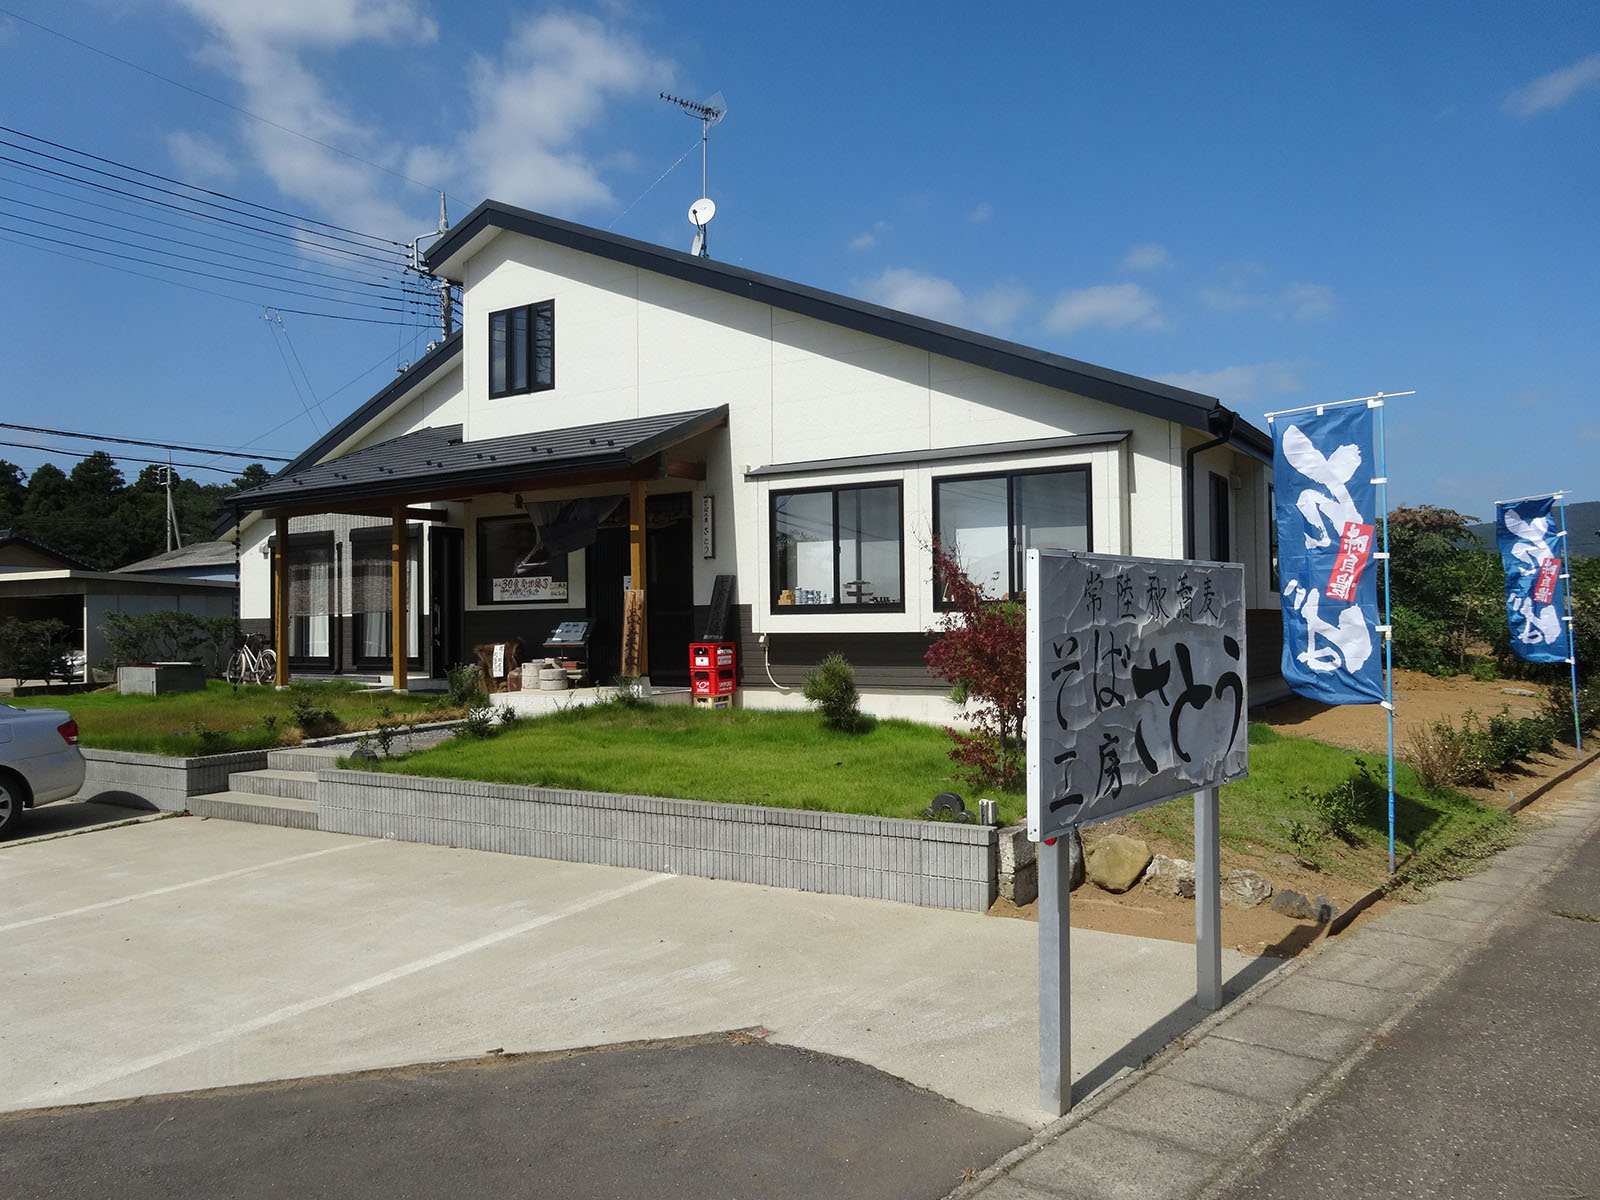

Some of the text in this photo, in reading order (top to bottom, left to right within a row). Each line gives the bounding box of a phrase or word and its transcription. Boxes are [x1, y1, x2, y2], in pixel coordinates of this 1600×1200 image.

[1052, 629, 1131, 731] そば
[1131, 634, 1244, 775] さとう
[1049, 732, 1121, 813] 工房
